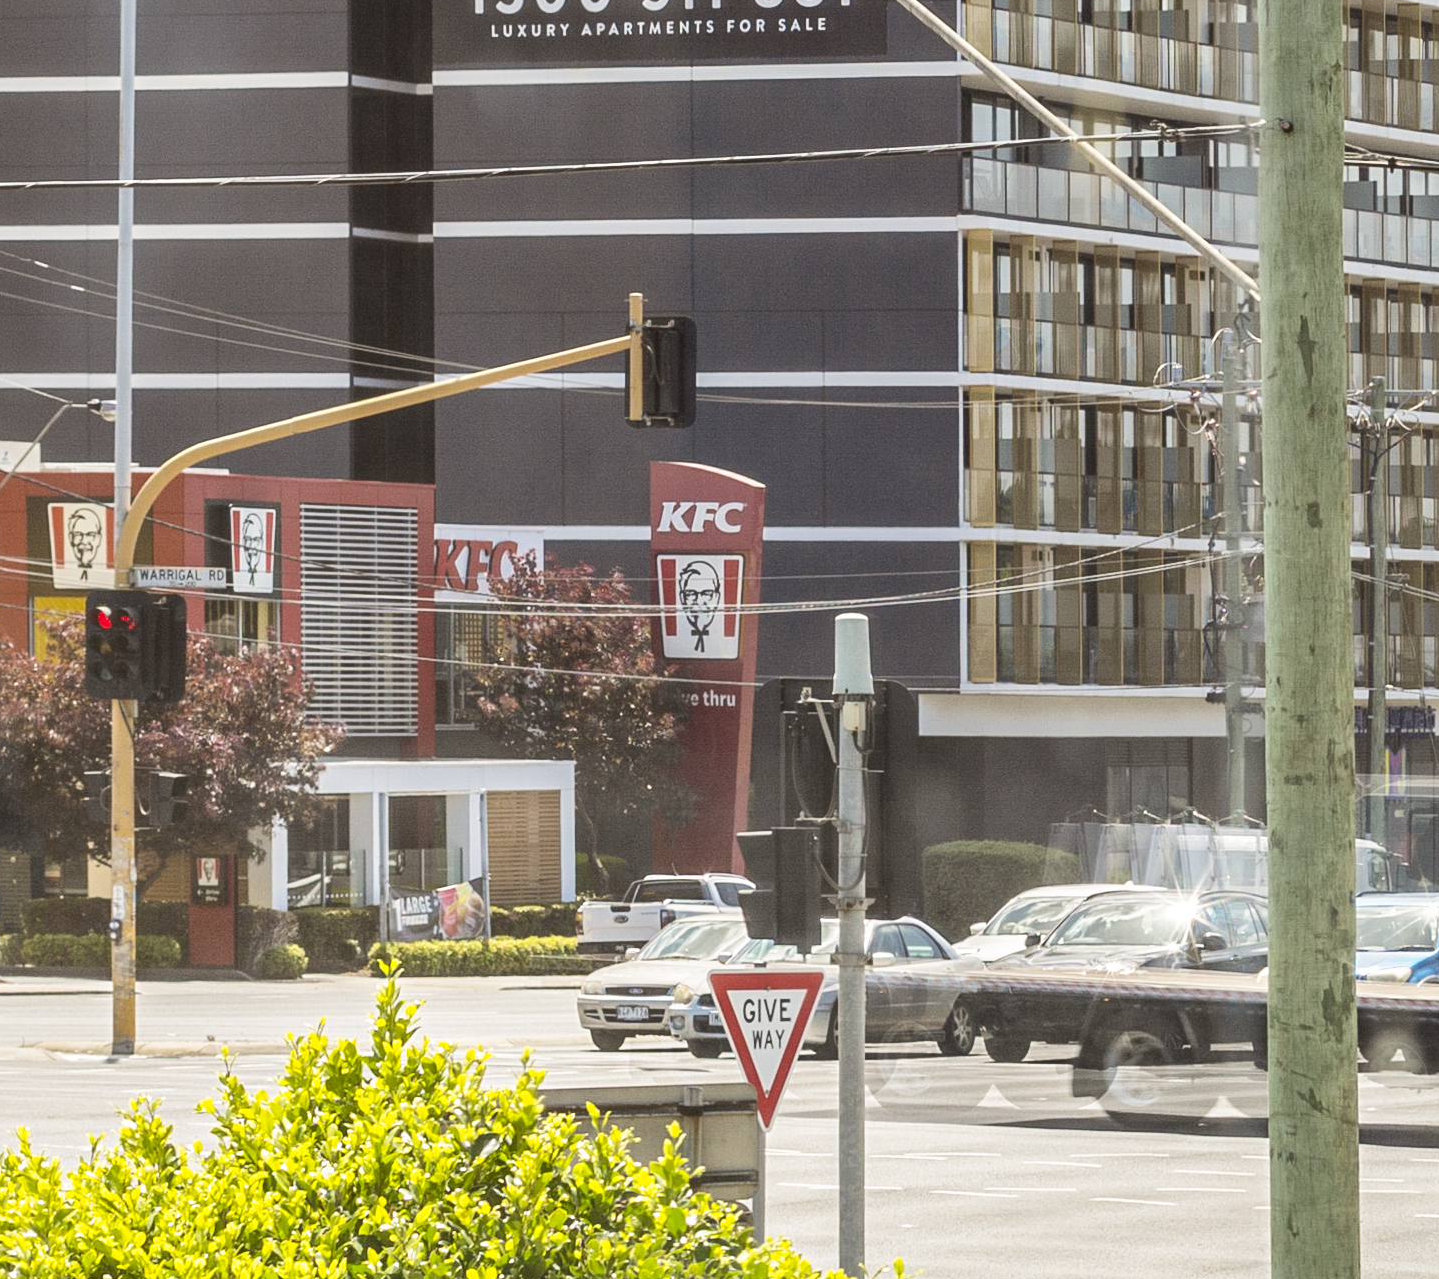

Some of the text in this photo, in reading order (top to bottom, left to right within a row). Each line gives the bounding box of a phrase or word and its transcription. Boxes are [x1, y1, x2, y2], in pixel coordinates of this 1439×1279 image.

[491, 17, 827, 38] LUXURY APARTMENTS FOR SALE
[656, 501, 745, 534] KFC
[140, 568, 225, 581] WARRIGAL RD
[434, 538, 519, 593] KFC
[702, 689, 736, 708] thru
[401, 895, 434, 915] LARGE
[742, 998, 792, 1024] GIVE
[752, 1029, 785, 1050] WAY
